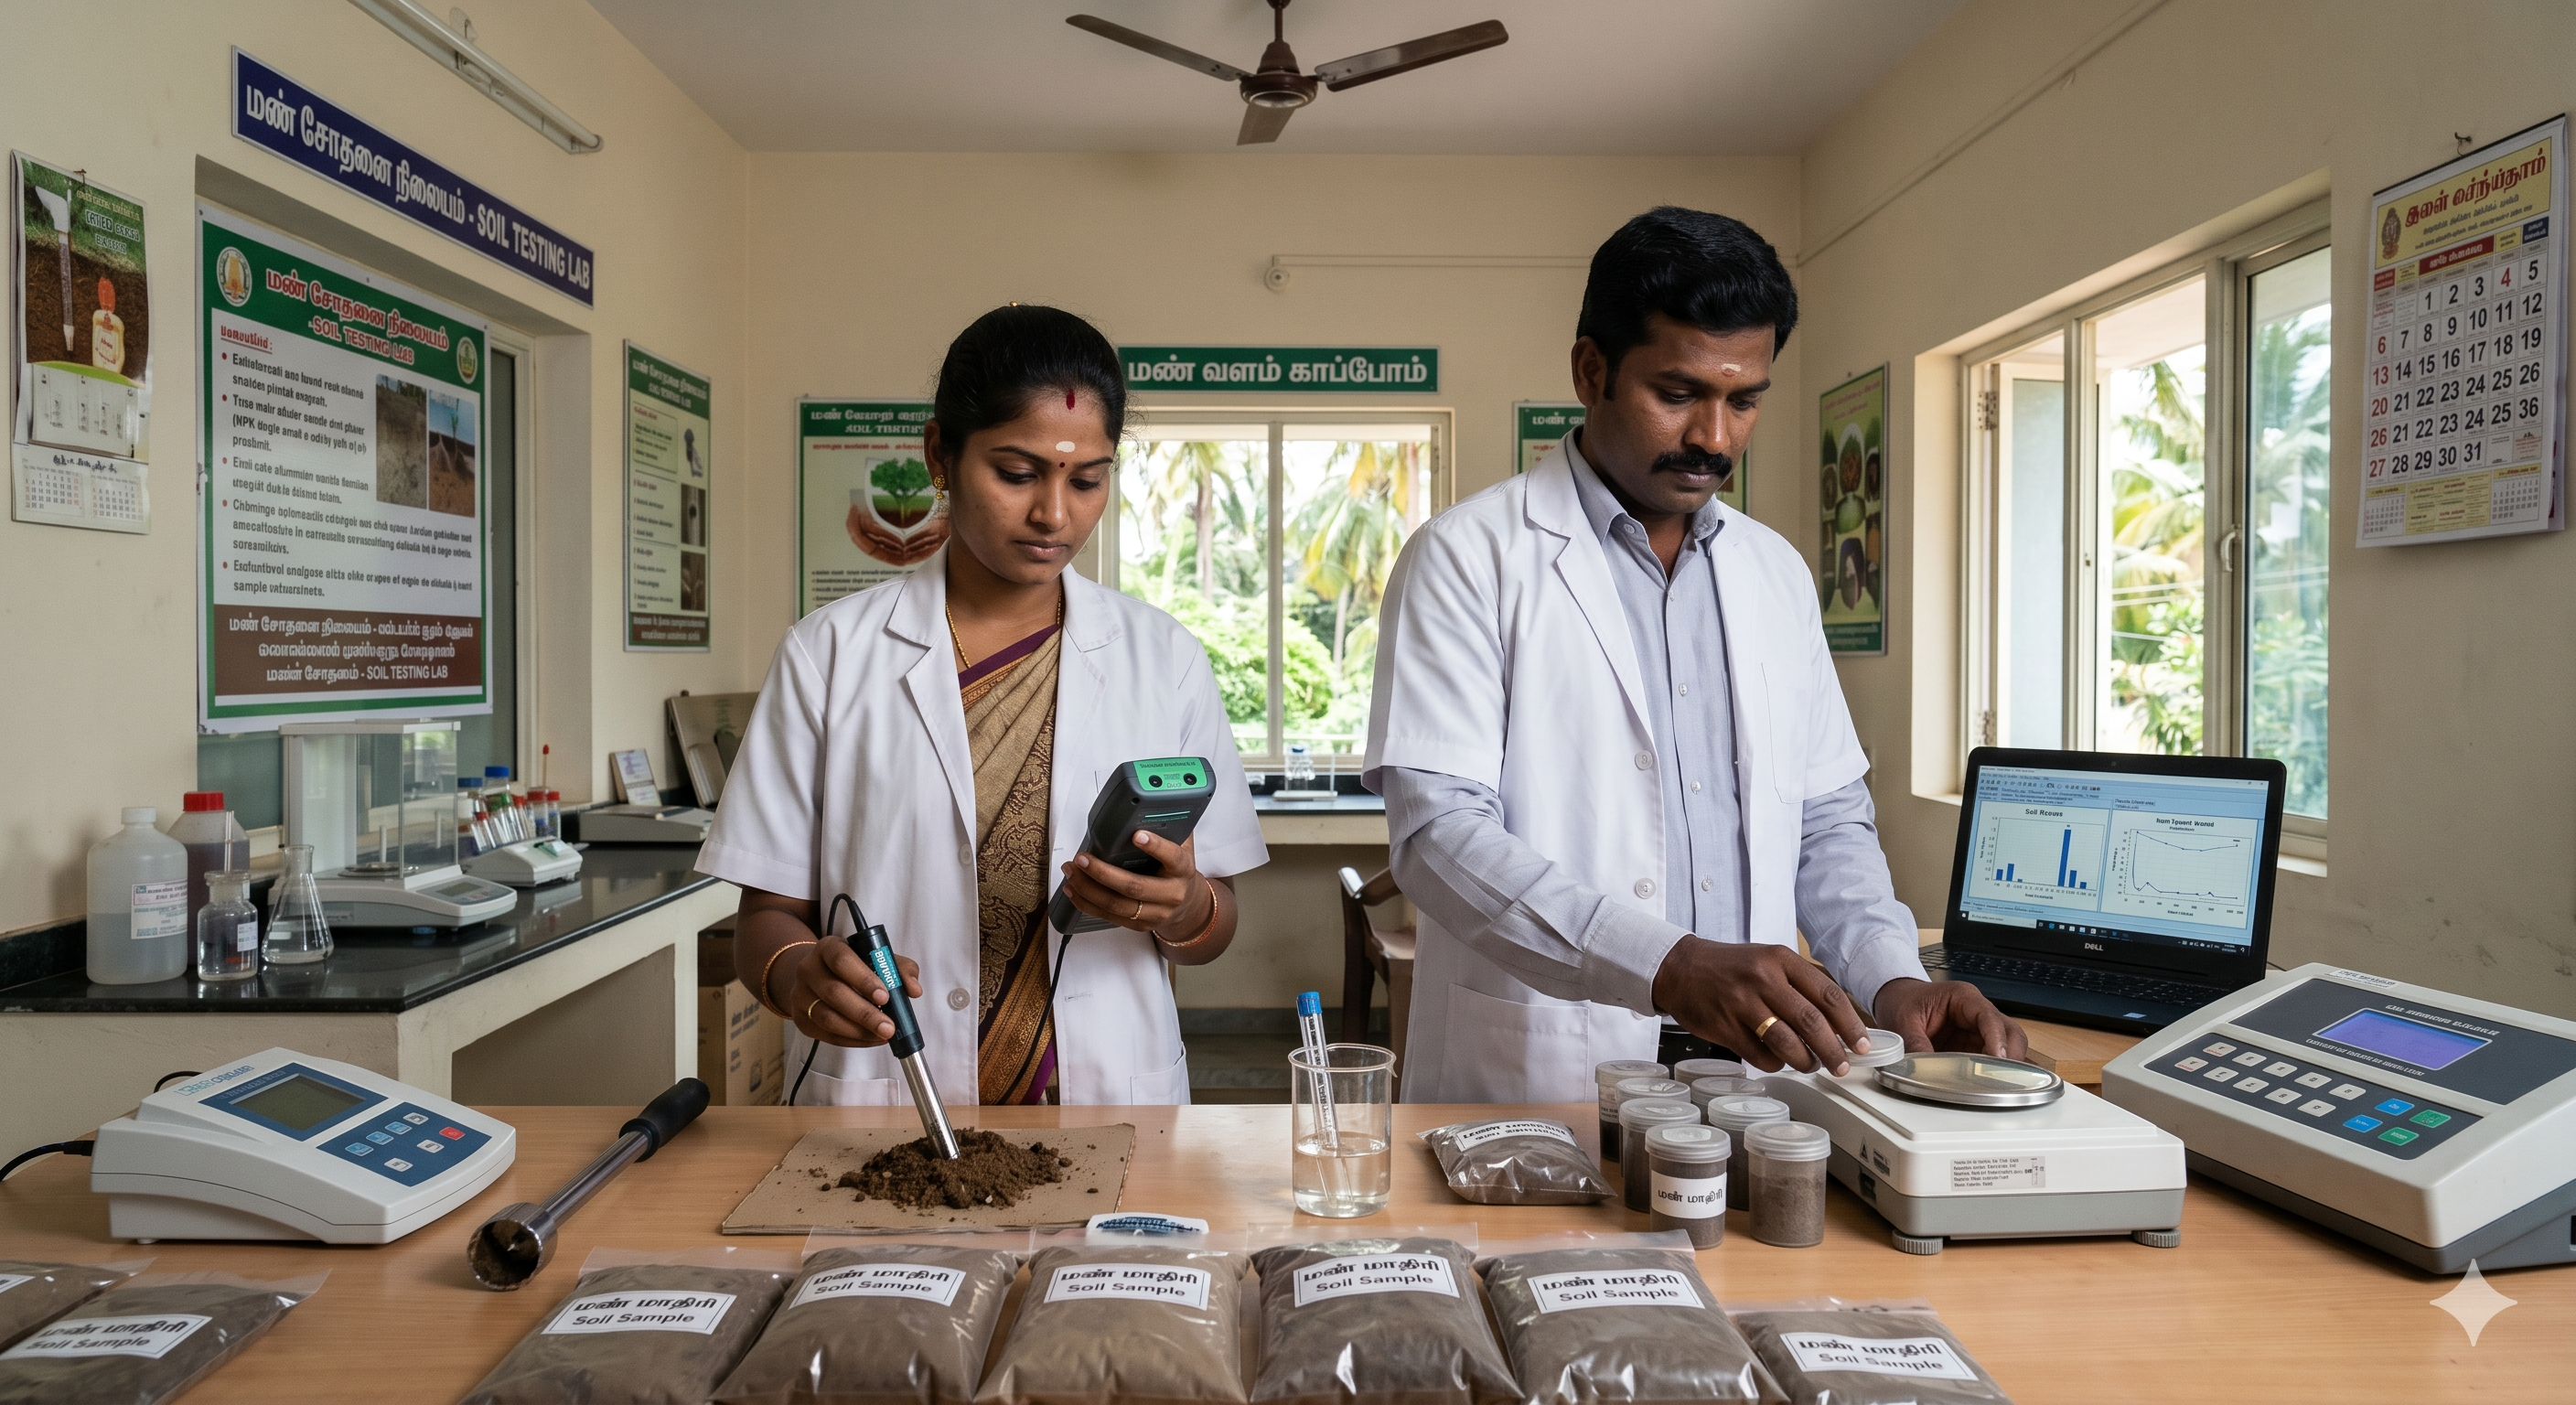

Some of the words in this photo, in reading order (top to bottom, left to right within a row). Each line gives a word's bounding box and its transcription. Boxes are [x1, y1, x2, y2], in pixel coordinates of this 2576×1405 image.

[246, 84, 296, 136] மண்
[300, 104, 392, 187] சோதனை
[396, 159, 466, 225] நிலையம்
[477, 203, 510, 248] SOIL
[513, 223, 566, 277] TESTING
[568, 252, 591, 291] LAB
[267, 269, 307, 301] மண்
[2425, 292, 2431, 311] 1
[2448, 284, 2459, 305] 2
[2474, 276, 2485, 297] 3
[2500, 267, 2511, 288] 4
[2528, 260, 2538, 280] 5
[2377, 336, 2387, 355] 6
[2400, 329, 2410, 349] 7
[2423, 323, 2433, 343] 8
[2447, 316, 2457, 336] 9
[2469, 307, 2487, 331] 10
[2495, 300, 2513, 323] 11
[2522, 292, 2542, 316] 12
[343, 327, 390, 358] TESTING
[2372, 365, 2389, 387] 13
[2395, 359, 2412, 381] 14
[2418, 353, 2436, 376] 15
[2442, 348, 2461, 370] 16
[2468, 340, 2487, 364] 17
[2494, 334, 2514, 358] 18
[2520, 327, 2542, 350] 19
[1127, 354, 1197, 382] மண்
[1202, 355, 1282, 382] வளம்
[1288, 355, 1428, 383] காப்போம்
[2371, 397, 2388, 417] 20
[2393, 391, 2410, 413] 21
[2416, 386, 2434, 408] 22
[2440, 380, 2460, 402] 23
[2465, 374, 2486, 397] 24
[2492, 368, 2513, 391] 25
[2518, 361, 2540, 386] 26
[232, 413, 255, 429] (NPK
[2370, 427, 2388, 448] 26
[2392, 423, 2409, 444] 21
[2415, 417, 2433, 440] 22
[2439, 413, 2459, 435] 23
[2464, 407, 2485, 431] 24
[2491, 402, 2512, 425] 25
[2518, 396, 2539, 420] 36
[2369, 458, 2387, 478] 27
[2391, 454, 2410, 475] 28
[2414, 450, 2432, 471] 29
[2438, 445, 2457, 467] 30
[2463, 441, 2482, 463] 31
[233, 581, 267, 595] sample
[229, 611, 259, 631] மண்
[367, 665, 390, 680] SOIL
[391, 665, 430, 680] TESTING
[431, 665, 448, 679] LAB
[2084, 941, 2104, 952] DELL
[1658, 1189, 1683, 1203] மண்
[812, 1269, 867, 1285] மண்
[872, 1270, 950, 1282] மாதிரி
[1060, 1269, 1116, 1282] மண்
[1122, 1271, 1197, 1284] மாதிரி
[1304, 1262, 1357, 1282] மண்
[1364, 1258, 1440, 1272] மாதிரி
[814, 1282, 853, 1294] Soil
[858, 1281, 932, 1292] Sample
[1067, 1282, 1105, 1292] Soil
[1111, 1282, 1186, 1296] Sample
[1315, 1278, 1353, 1292] Soil
[1359, 1274, 1433, 1285] Sample
[1542, 1276, 1596, 1291] மண்
[1603, 1273, 1680, 1287] மாதிரி
[573, 1297, 633, 1312] மண்
[636, 1297, 717, 1311] மாதிரி
[1559, 1291, 1598, 1303] Soil
[1605, 1288, 1680, 1300] Sample
[572, 1314, 615, 1325] Soil
[617, 1313, 695, 1325] Sample
[26, 1339, 73, 1350] Soil
[72, 1336, 151, 1349] Sample
[1798, 1339, 1855, 1353] மண்
[1861, 1343, 1942, 1358] மாதிரி
[1819, 1353, 1860, 1364] Soil
[1865, 1357, 1944, 1371] Sample
